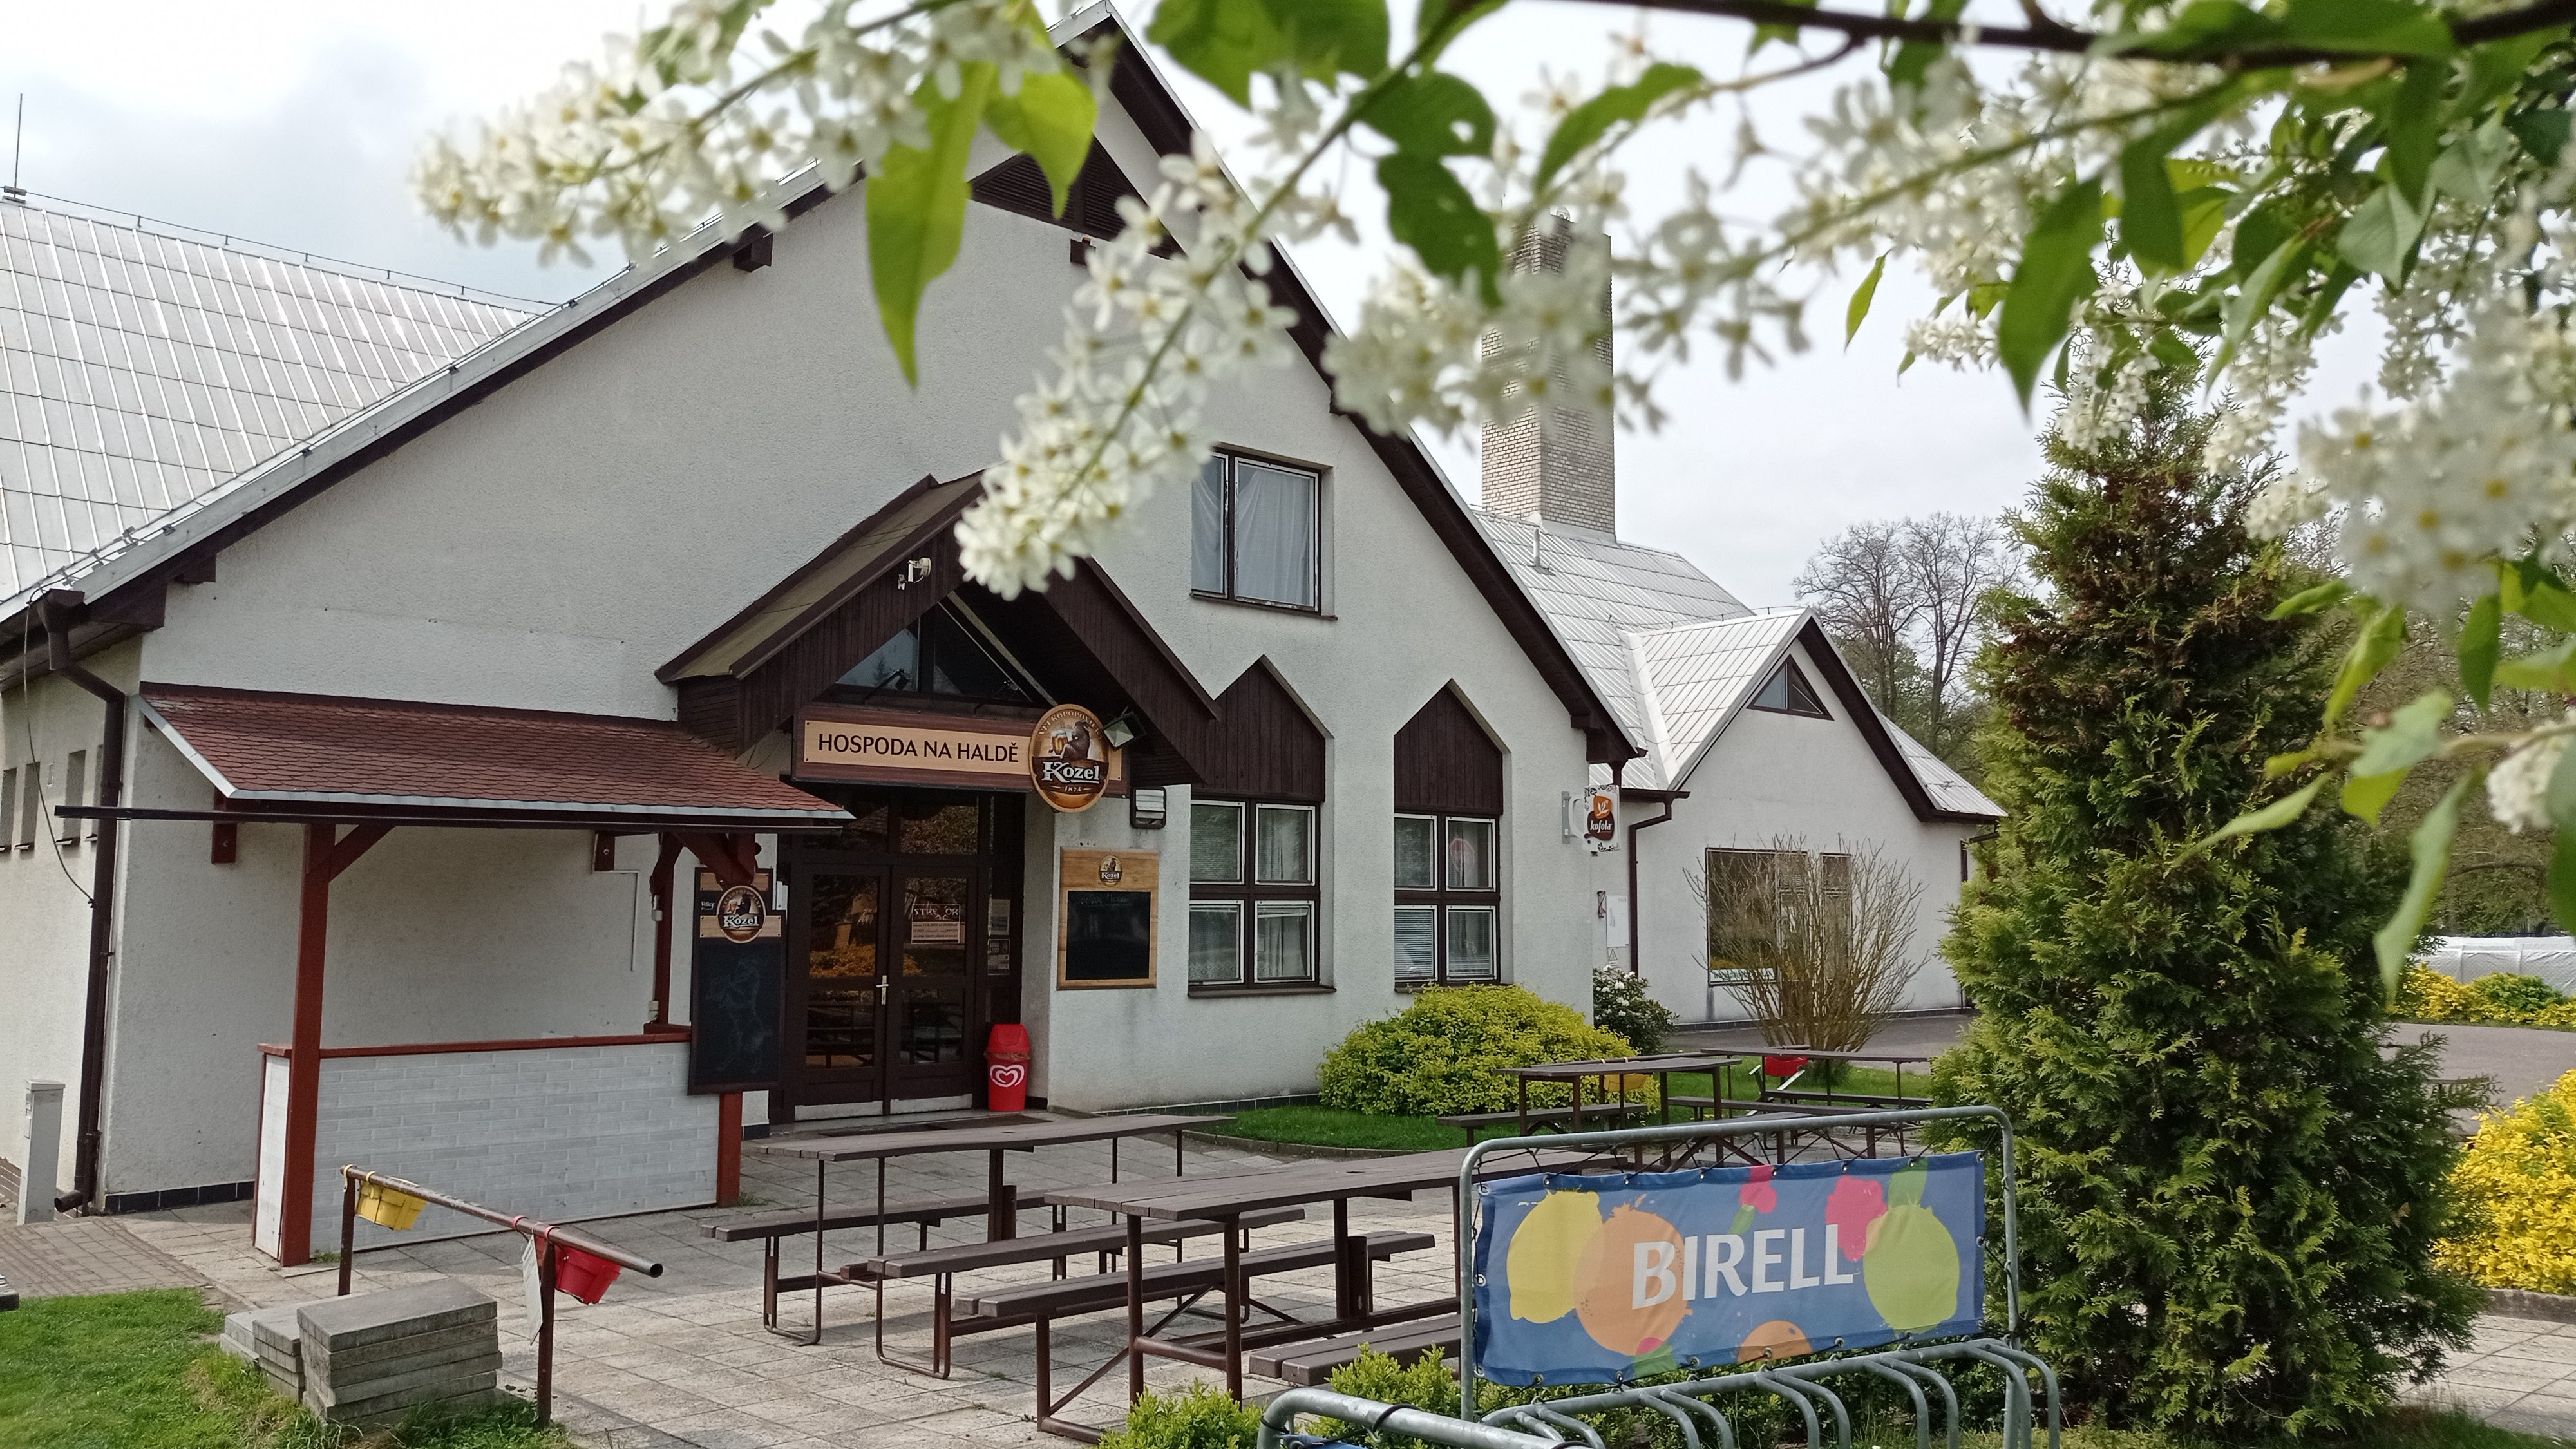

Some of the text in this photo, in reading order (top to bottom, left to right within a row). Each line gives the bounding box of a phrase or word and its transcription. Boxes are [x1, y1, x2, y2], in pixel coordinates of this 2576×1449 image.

[819, 733, 1019, 762] HOSPODA NA HALDĚ
[1041, 761, 1100, 784] Kozel
[1589, 820, 1611, 833] kofola
[723, 915, 760, 928] Kozel
[1631, 1223, 1854, 1311] BIRELL
